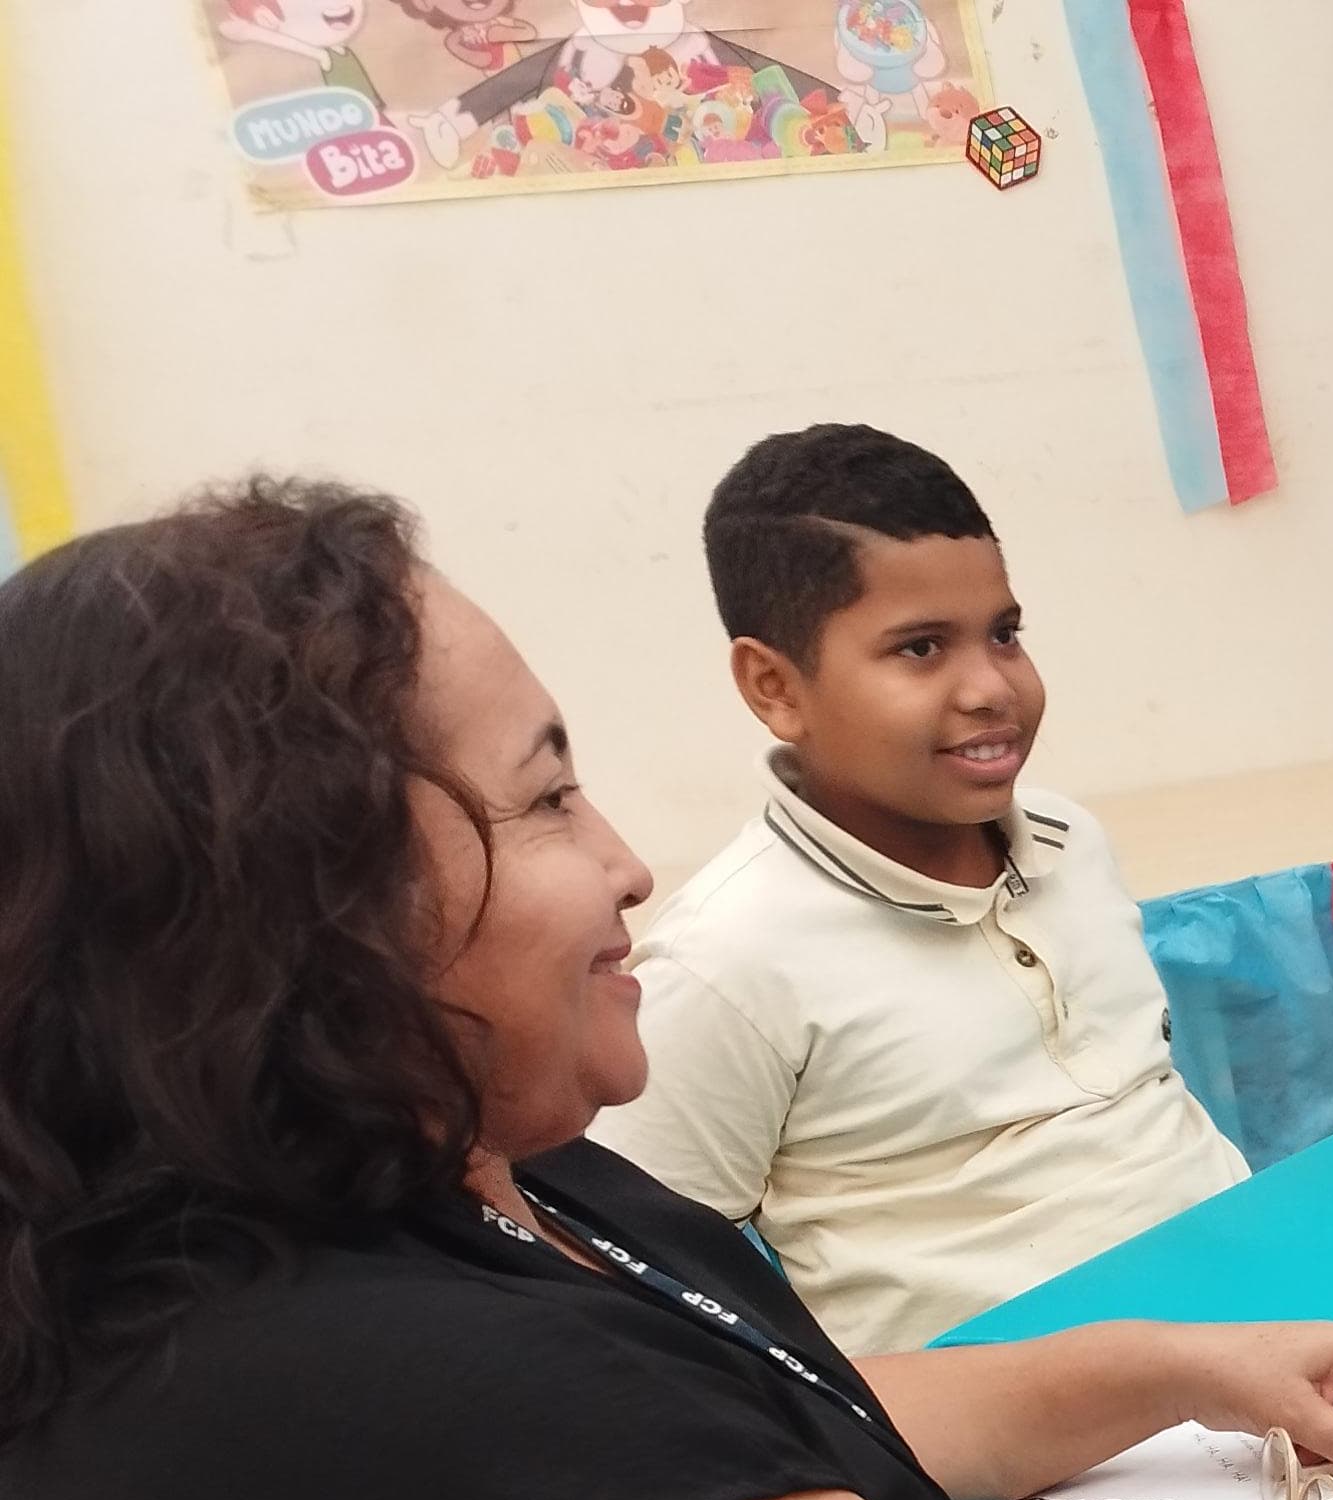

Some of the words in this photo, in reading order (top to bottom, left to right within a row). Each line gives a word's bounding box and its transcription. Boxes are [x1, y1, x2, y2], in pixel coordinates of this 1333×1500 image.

[248, 103, 363, 150] MUNDO
[319, 140, 406, 188] Bita
[482, 1205, 536, 1243] FCP
[592, 1237, 649, 1276] FCP
[681, 1291, 738, 1325] FCP
[768, 1346, 819, 1383] FCP
